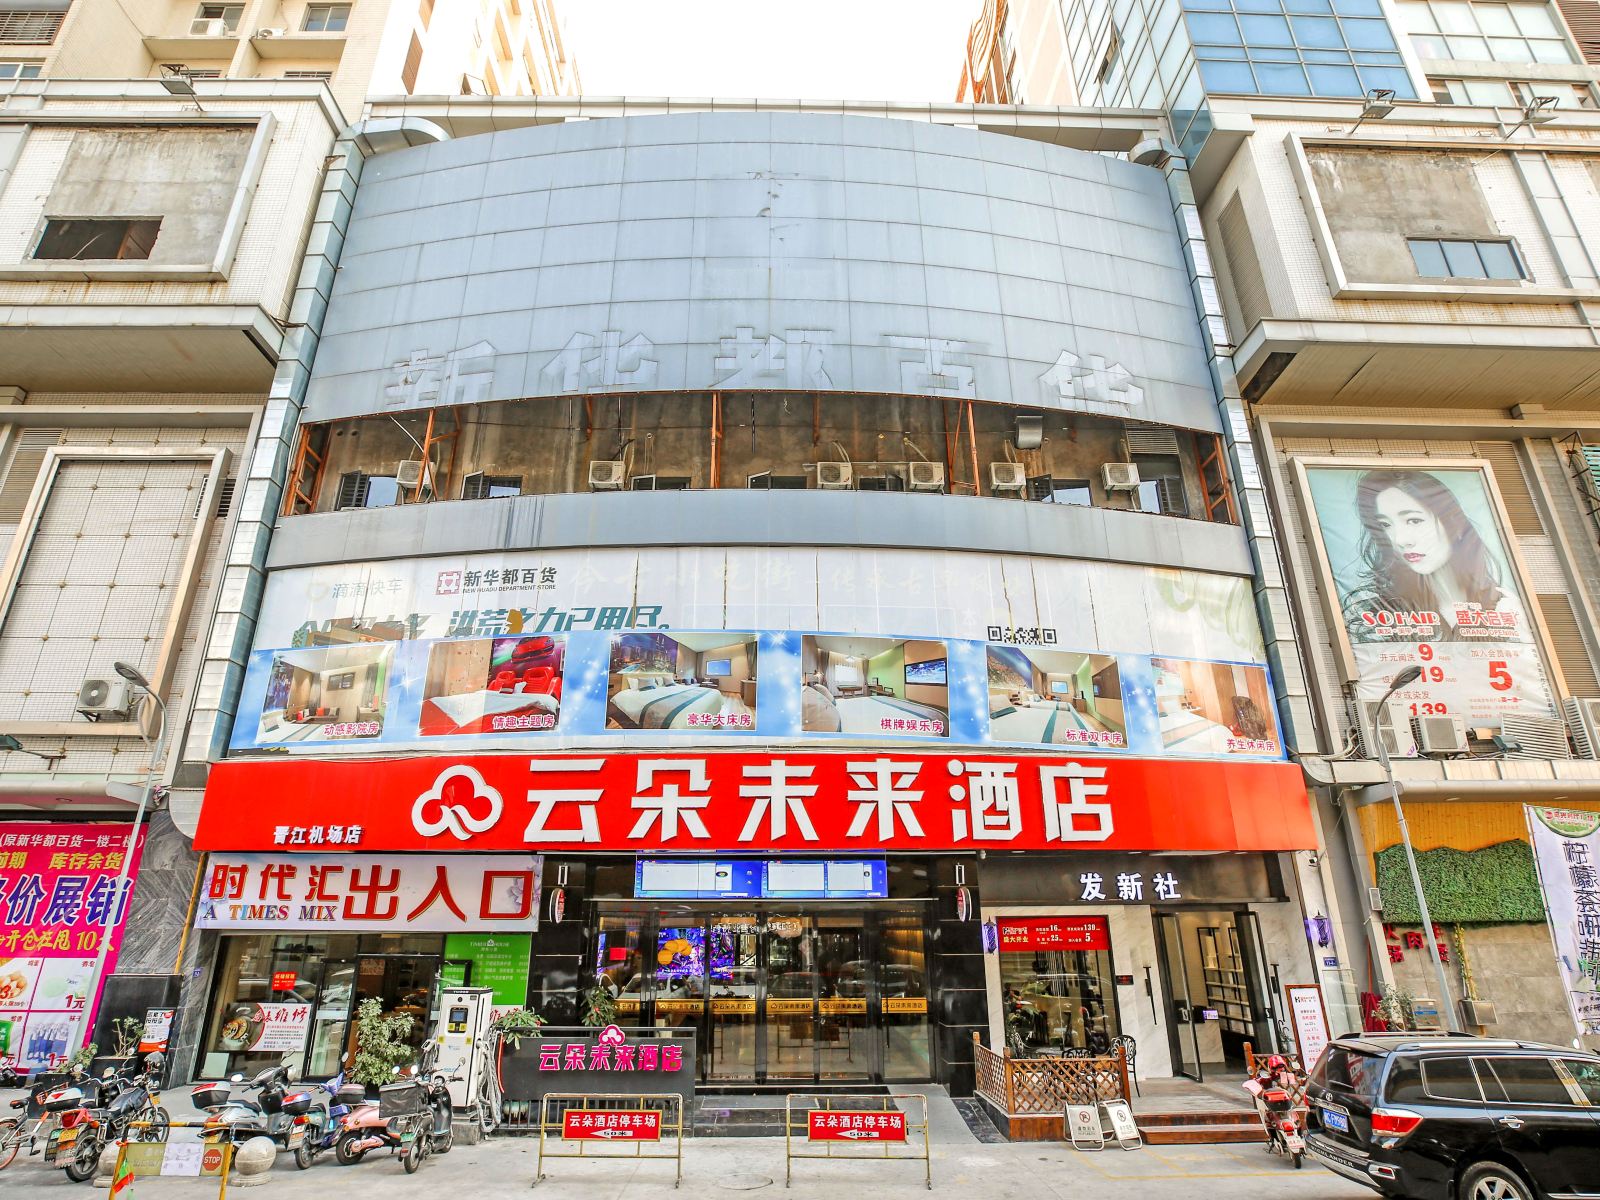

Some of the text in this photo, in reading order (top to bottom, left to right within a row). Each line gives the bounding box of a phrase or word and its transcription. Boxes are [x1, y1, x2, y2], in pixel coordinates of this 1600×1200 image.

[464, 567, 557, 587] 新华都百货
[1460, 628, 1520, 637] GRAND OPENING
[1418, 643, 1434, 661] 9
[1419, 666, 1444, 683] 19
[1488, 661, 1513, 691] 5
[1410, 702, 1447, 716] 139
[492, 712, 556, 730] 情趣主题房
[687, 712, 752, 727] 豪华大床房
[880, 717, 945, 734] 棋牌娱乐房
[324, 722, 380, 736] 动感影院房
[1065, 728, 1123, 745] 标准双床房
[1226, 737, 1276, 753] 养生休闲房
[523, 757, 1114, 843] 云朵未来酒店
[272, 824, 364, 845] 晋江机场店
[48, 852, 125, 870] 库存余货
[1080, 871, 1182, 901] 发新社
[202, 904, 338, 922] A TIMES MIX
[65, 994, 86, 1009] 1元
[539, 1043, 683, 1072] 云朵未来酒店
[569, 1114, 656, 1128] 云朵酒店停车场
[814, 1115, 901, 1129] 云朵酒店停车场
[203, 1156, 221, 1165] STOP
[1310, 1145, 1355, 1168] HIGHLANDER
